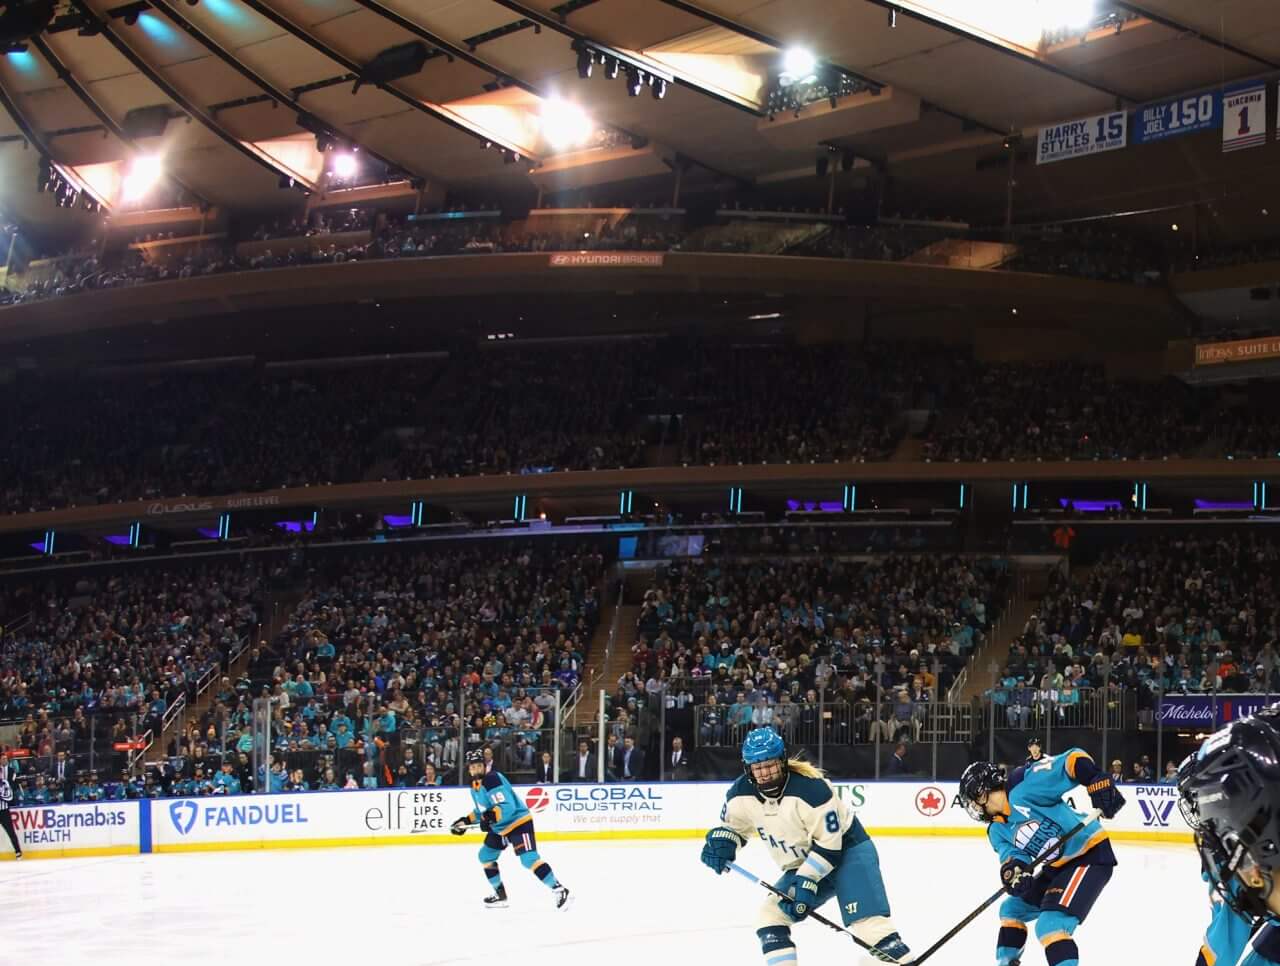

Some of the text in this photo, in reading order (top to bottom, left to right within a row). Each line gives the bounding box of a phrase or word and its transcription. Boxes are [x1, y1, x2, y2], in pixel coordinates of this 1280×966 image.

[1168, 94, 1214, 129] 150
[1237, 106, 1251, 136] 1
[1045, 121, 1087, 140] HARRY
[1094, 114, 1123, 143] 15
[1143, 120, 1165, 137] JOEL
[1040, 133, 1090, 154] STYLES
[571, 255, 621, 265] HYUNDAI
[1238, 343, 1269, 356] SUITE
[163, 496, 281, 514] LEXUS SUITE LEVEL
[1159, 702, 1218, 721] Michelo
[555, 787, 663, 801] GLOBAL
[1136, 786, 1178, 797] PWHL
[205, 803, 308, 826] FANDUEL
[365, 791, 409, 831] elf
[555, 801, 663, 812] INDUSTRIAL
[11, 806, 126, 831] RWJBarnabas
[590, 815, 607, 823] can
[609, 815, 639, 825] supply
[824, 810, 840, 834] 8
[24, 830, 71, 844] HEALTH
[757, 826, 809, 859] EATT
